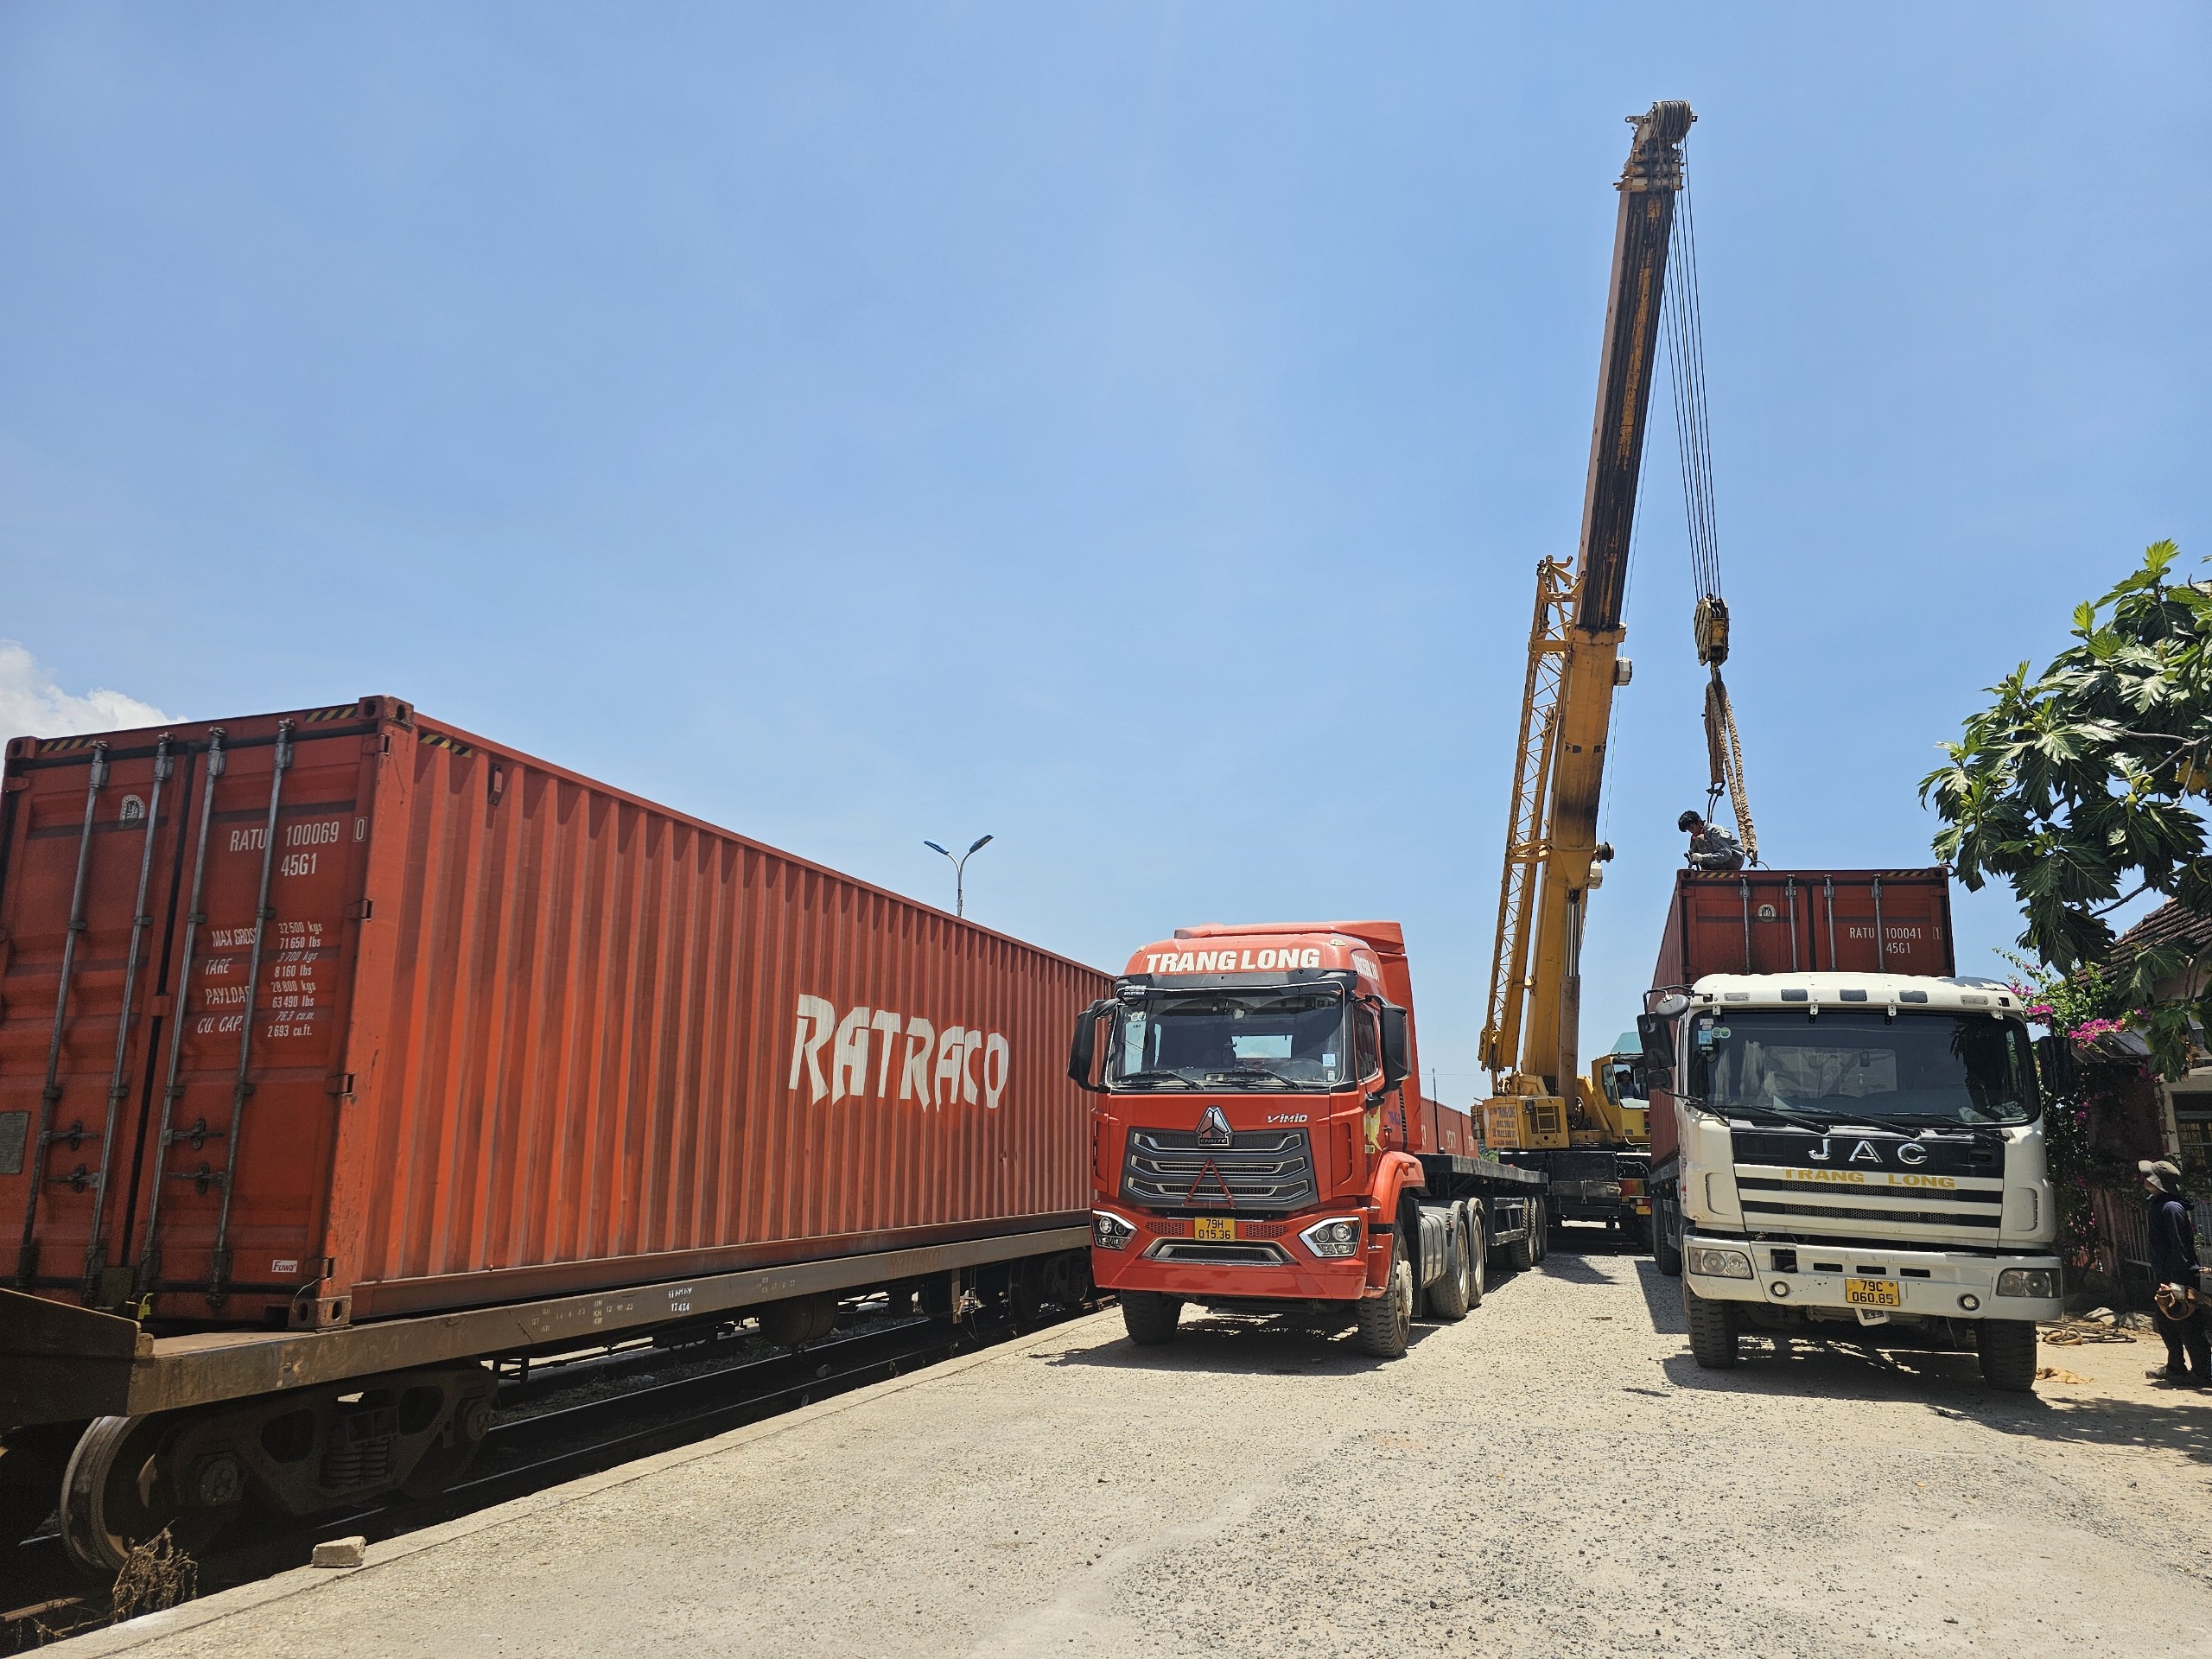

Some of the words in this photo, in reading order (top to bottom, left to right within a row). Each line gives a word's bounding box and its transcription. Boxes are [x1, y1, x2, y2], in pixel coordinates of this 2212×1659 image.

[229, 828, 269, 852] RATU
[286, 821, 340, 847] 100069
[355, 818, 365, 841] 0
[281, 853, 317, 877] 45G1
[308, 921, 323, 935] kgs
[1849, 927, 1875, 938] RATU
[1885, 927, 1922, 939] 100041
[212, 929, 232, 948] MAX
[308, 936, 321, 948] lbs
[1885, 942, 1911, 954] 45G1
[302, 950, 318, 963] kgs
[1146, 950, 1237, 974] TRANG
[1241, 948, 1320, 969] LONG
[205, 957, 233, 976] TARE
[299, 964, 312, 976] lbs
[300, 980, 316, 994] kgs
[302, 995, 315, 1007] lbs
[276, 1010, 295, 1021] 76.3
[197, 1016, 214, 1033] CU.
[219, 1014, 243, 1033] CAP.
[788, 993, 1009, 1114] RATRACO
[1808, 1138, 1929, 1165] JAC
[1784, 1168, 1865, 1183] TRANG
[1888, 1173, 1955, 1188] LONG
[1206, 1218, 1224, 1229] 79H
[1198, 1229, 1230, 1240] 015.36
[1859, 1280, 1883, 1292] 79C
[1852, 1291, 1894, 1305] 060.85
